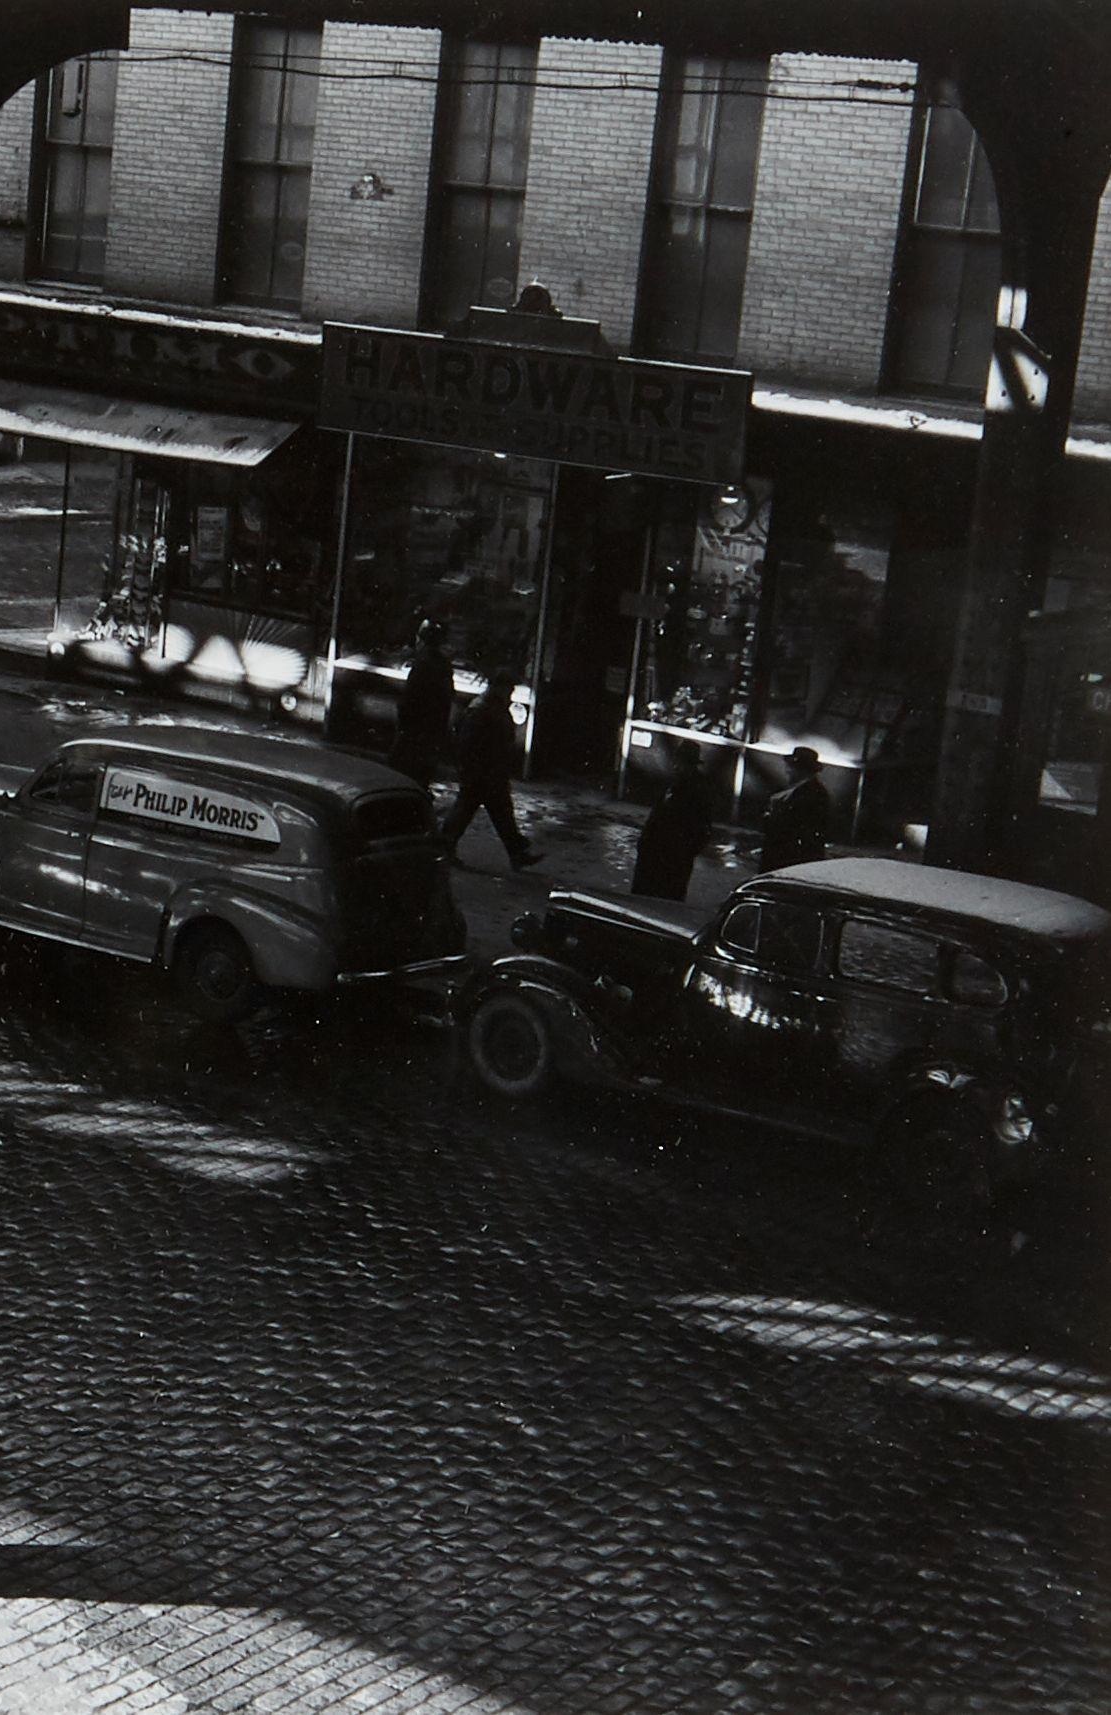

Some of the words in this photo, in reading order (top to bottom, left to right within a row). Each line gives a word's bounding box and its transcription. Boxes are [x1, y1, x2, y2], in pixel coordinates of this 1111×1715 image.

[344, 335, 725, 432] HARDWARE
[513, 417, 708, 471] SUPPLIES
[133, 783, 188, 816] PHILIP
